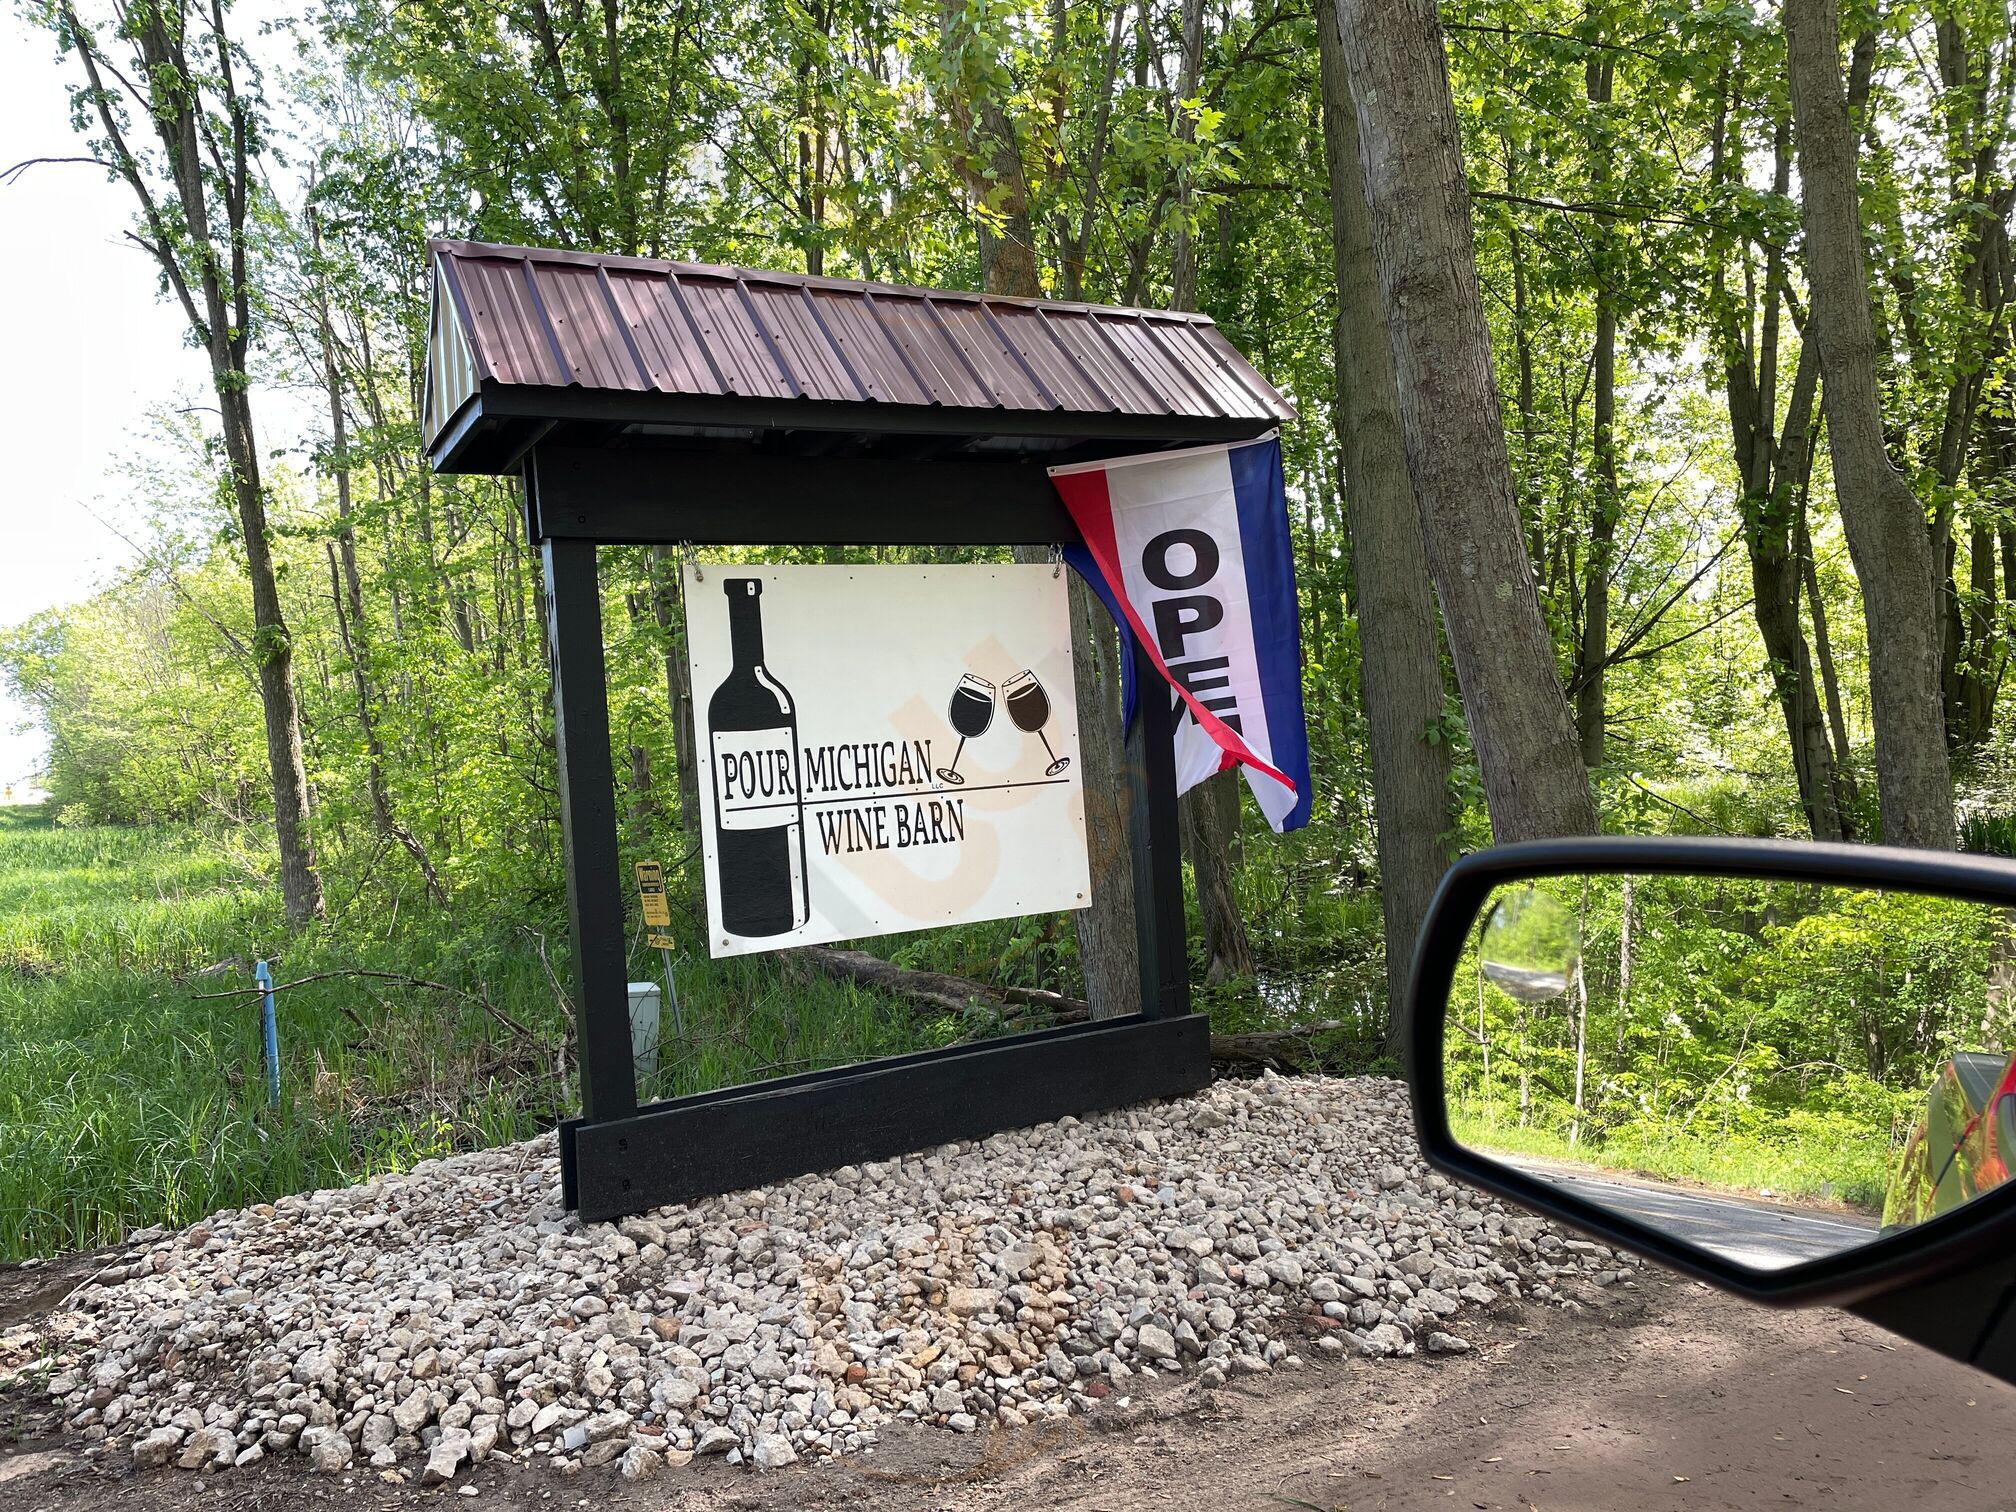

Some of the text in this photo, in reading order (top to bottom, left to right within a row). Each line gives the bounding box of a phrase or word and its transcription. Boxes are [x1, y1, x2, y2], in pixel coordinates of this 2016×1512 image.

[1141, 528, 1243, 738] OPE
[721, 740, 932, 800] POUR MICHIGAN
[931, 782, 944, 790] LLC
[816, 799, 965, 856] WINE BARN
